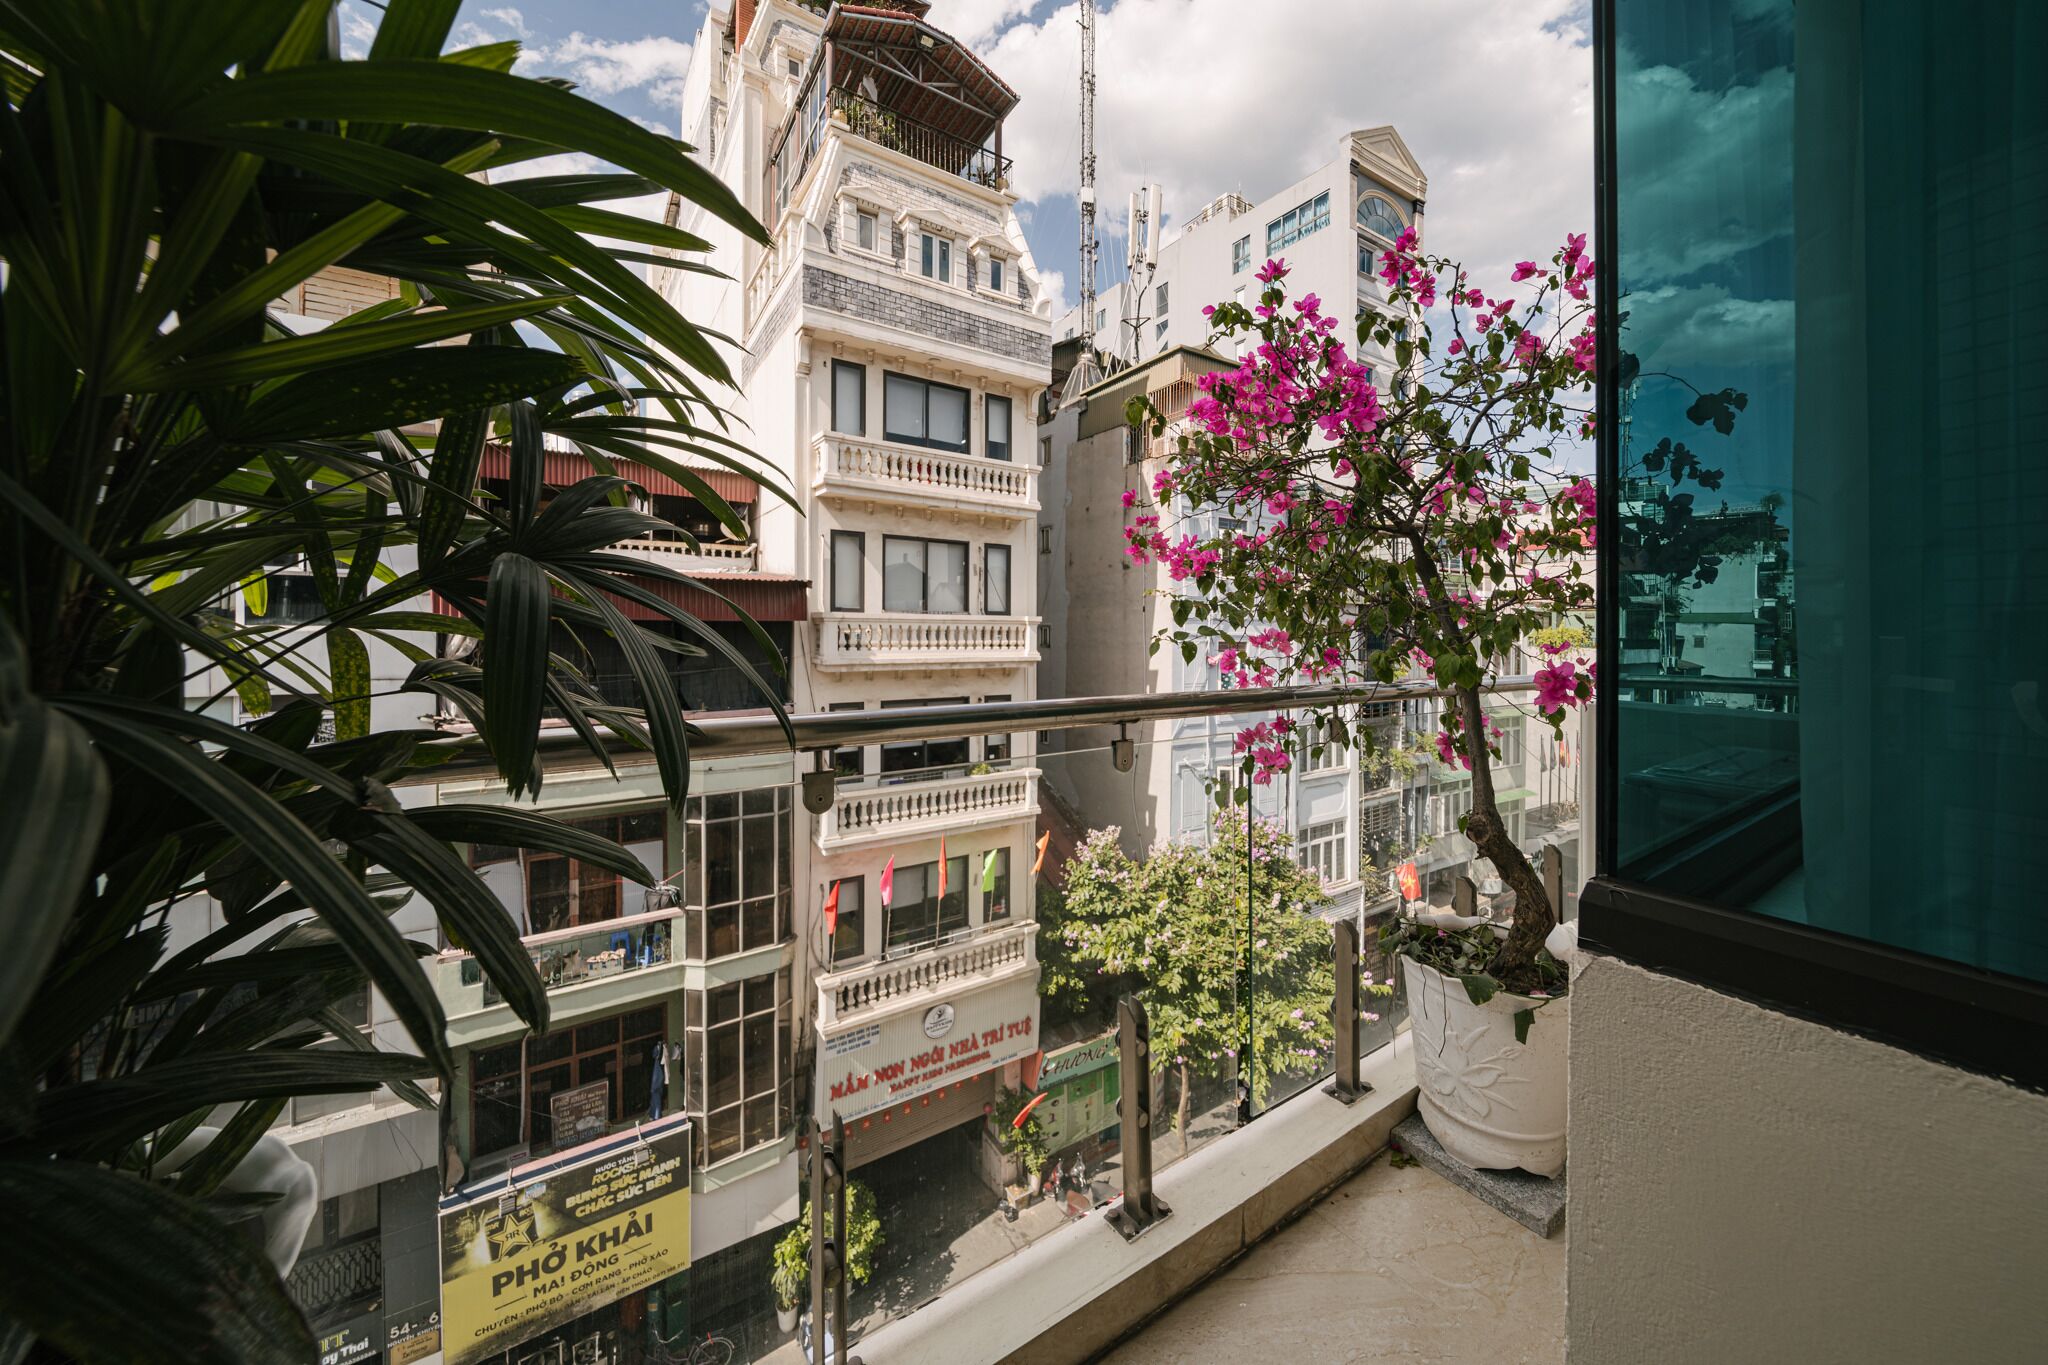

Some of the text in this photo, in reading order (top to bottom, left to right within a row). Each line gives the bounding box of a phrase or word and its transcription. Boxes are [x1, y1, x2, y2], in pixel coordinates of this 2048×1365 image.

[875, 1060, 905, 1086] NON
[592, 1154, 656, 1185] ROCKSR
[492, 1210, 653, 1298] PHỞ KHẢI
[570, 1253, 619, 1283] ĐỘNG
[595, 1268, 622, 1285] RANG
[340, 1337, 369, 1357] Thai
